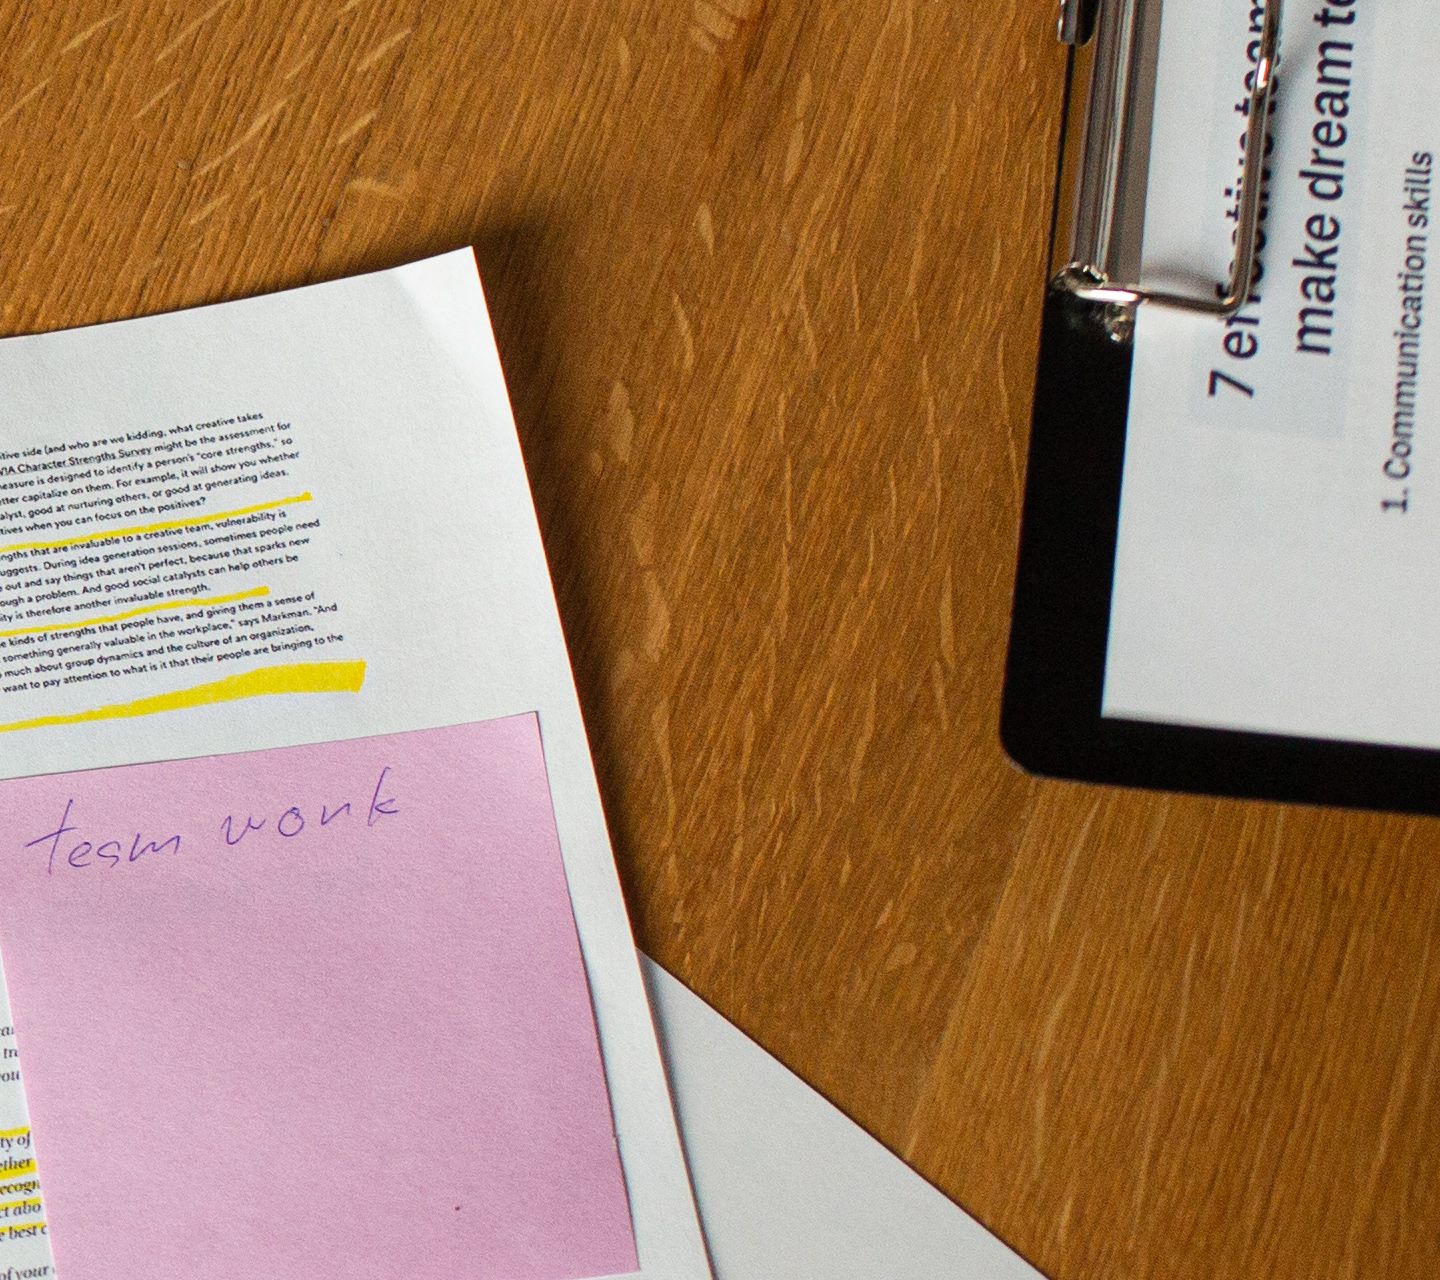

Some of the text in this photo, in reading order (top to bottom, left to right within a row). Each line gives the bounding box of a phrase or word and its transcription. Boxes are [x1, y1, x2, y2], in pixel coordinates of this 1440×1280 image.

[1297, 39, 1354, 201] dream
[1290, 213, 1341, 355] make
[1379, 150, 1433, 513] 1. Communication skills
[1207, 370, 1255, 399] 7
[14, 610, 24, 620] is
[24, 604, 72, 618] therefore
[73, 598, 112, 611] another
[113, 589, 164, 605] invaluable
[24, 798, 182, 876] team
